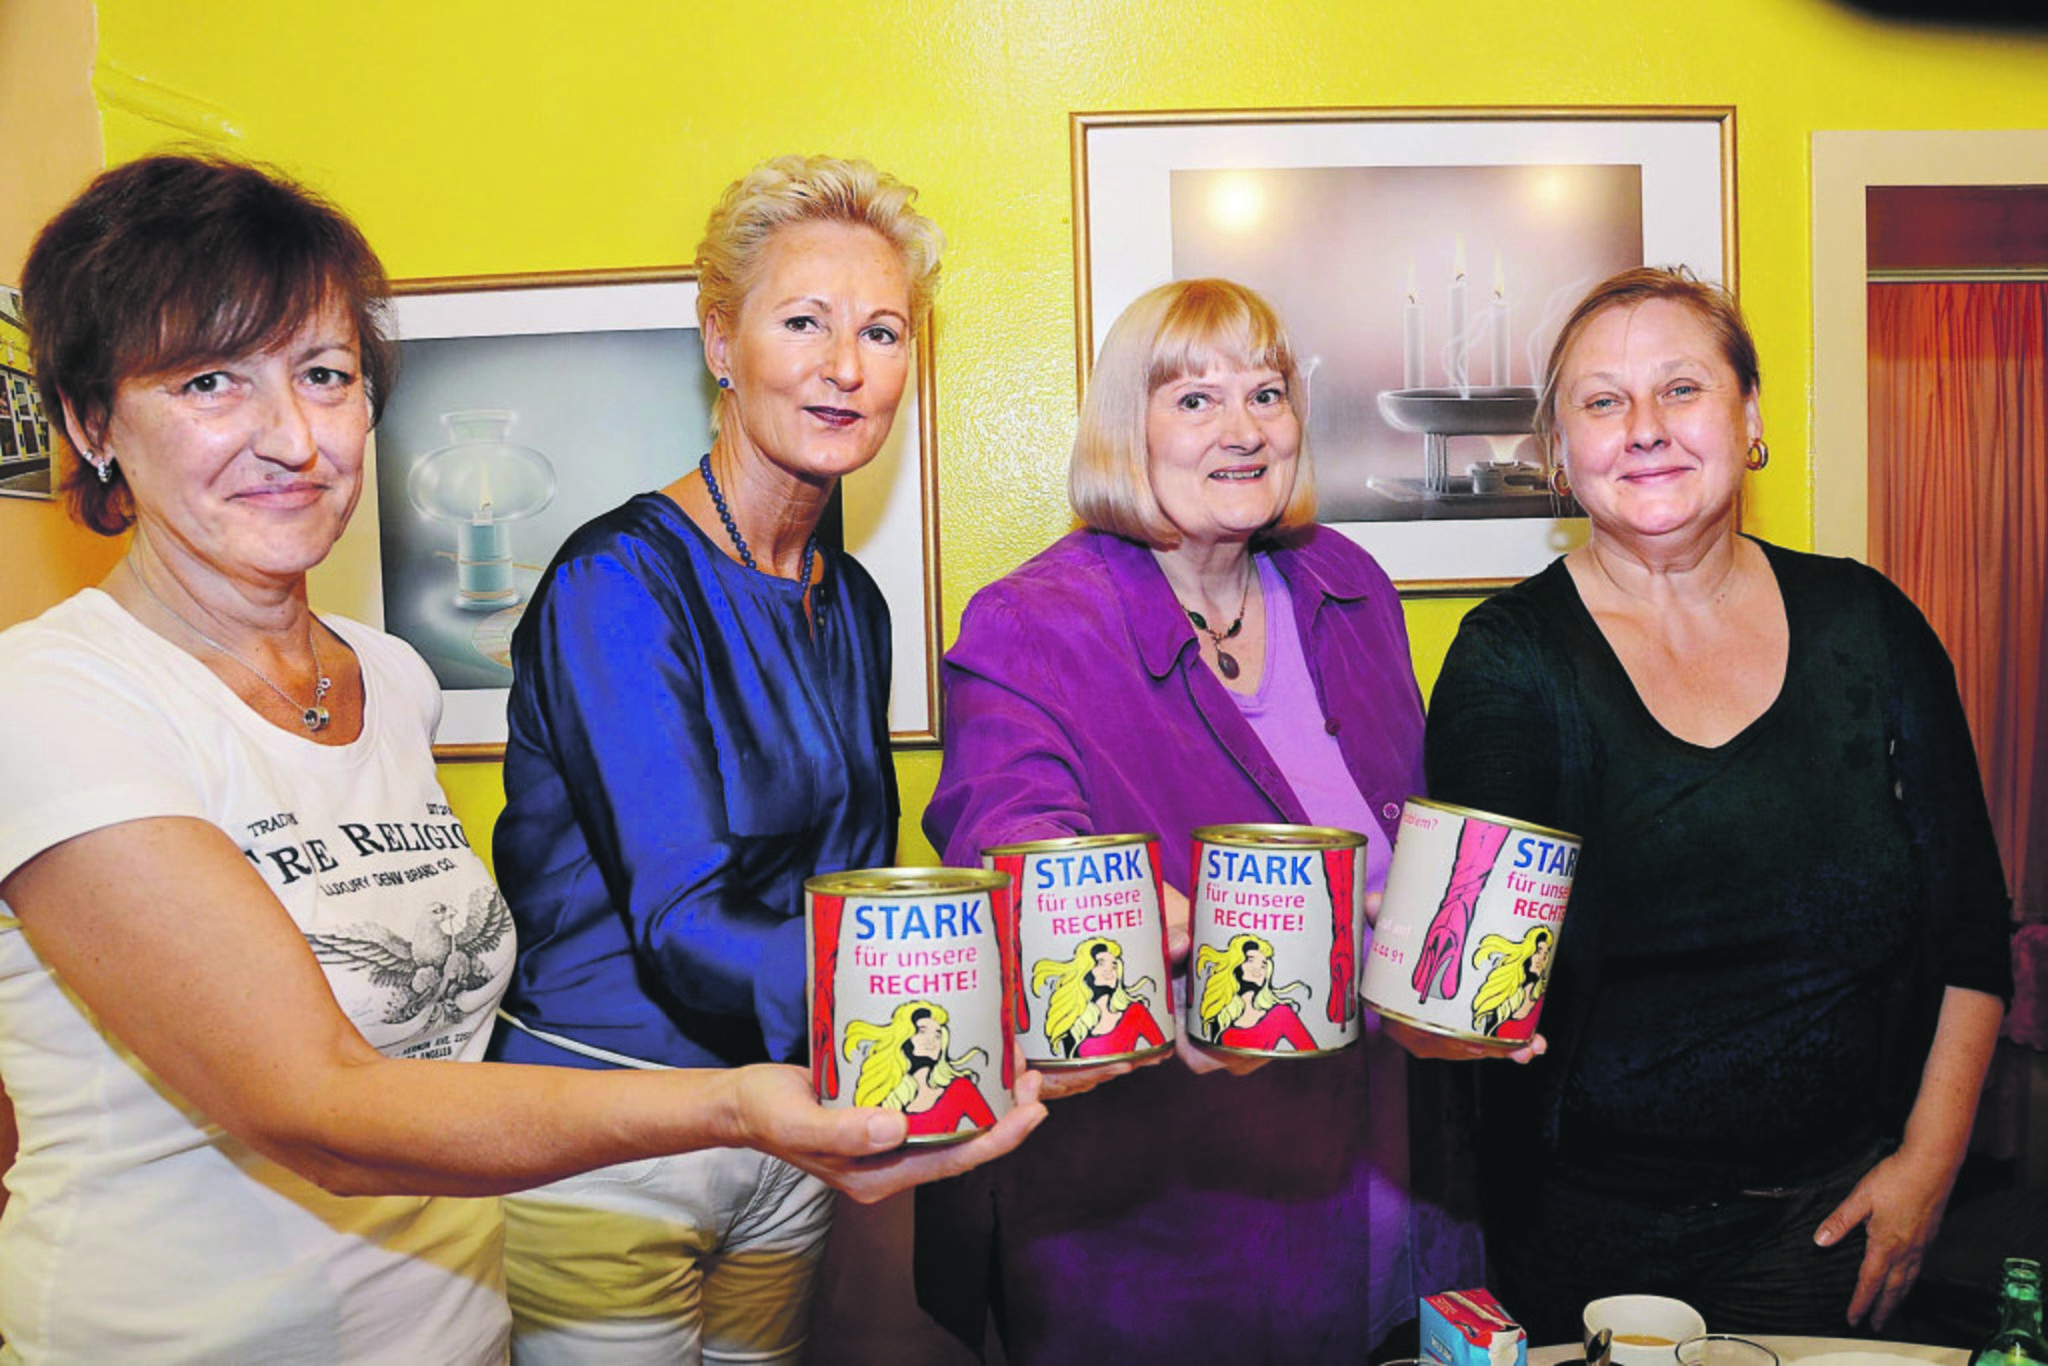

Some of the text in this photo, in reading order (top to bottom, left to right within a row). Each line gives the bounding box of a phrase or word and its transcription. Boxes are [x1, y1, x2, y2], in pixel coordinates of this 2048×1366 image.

[1034, 848, 1143, 889] STARK
[1207, 849, 1313, 886] STARK
[1206, 882, 1306, 909] für unsere
[1506, 871, 1537, 894] für
[1037, 889, 1141, 912] für unsere
[855, 899, 983, 940] STARK
[1052, 909, 1143, 935] RECHTE!
[1214, 908, 1305, 932] RECHTE!
[854, 944, 978, 968] für unsere
[869, 969, 978, 995] RECHTE!
